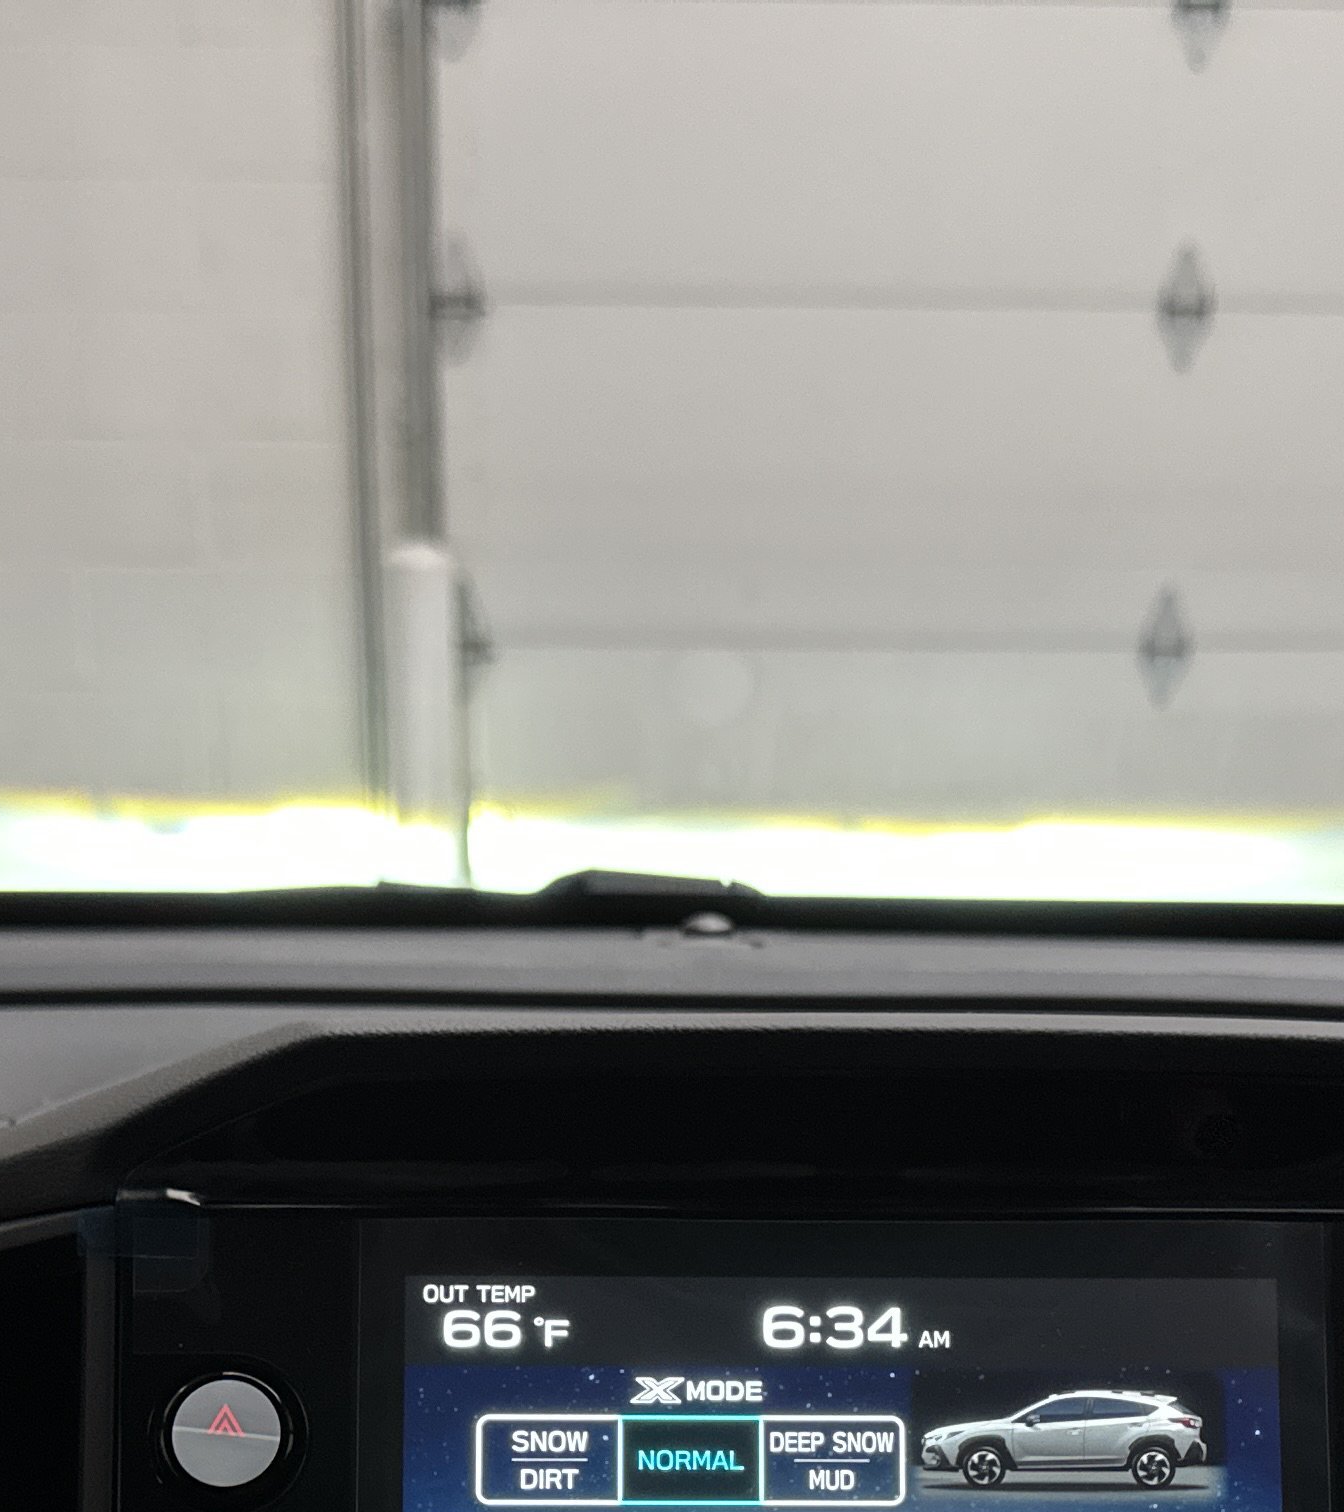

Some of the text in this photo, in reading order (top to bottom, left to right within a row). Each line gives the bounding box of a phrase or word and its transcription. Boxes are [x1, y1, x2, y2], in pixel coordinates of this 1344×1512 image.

[422, 1284, 537, 1304] OUT TEMP
[442, 1309, 523, 1350] 66
[761, 1304, 951, 1350] 6:34 AM
[685, 1380, 763, 1403] MODE
[511, 1429, 589, 1454] SNOW
[769, 1431, 895, 1455] DEEP SNOW
[637, 1449, 745, 1473] NORMAL
[519, 1468, 580, 1491] DIRT
[808, 1466, 856, 1491] MUD
